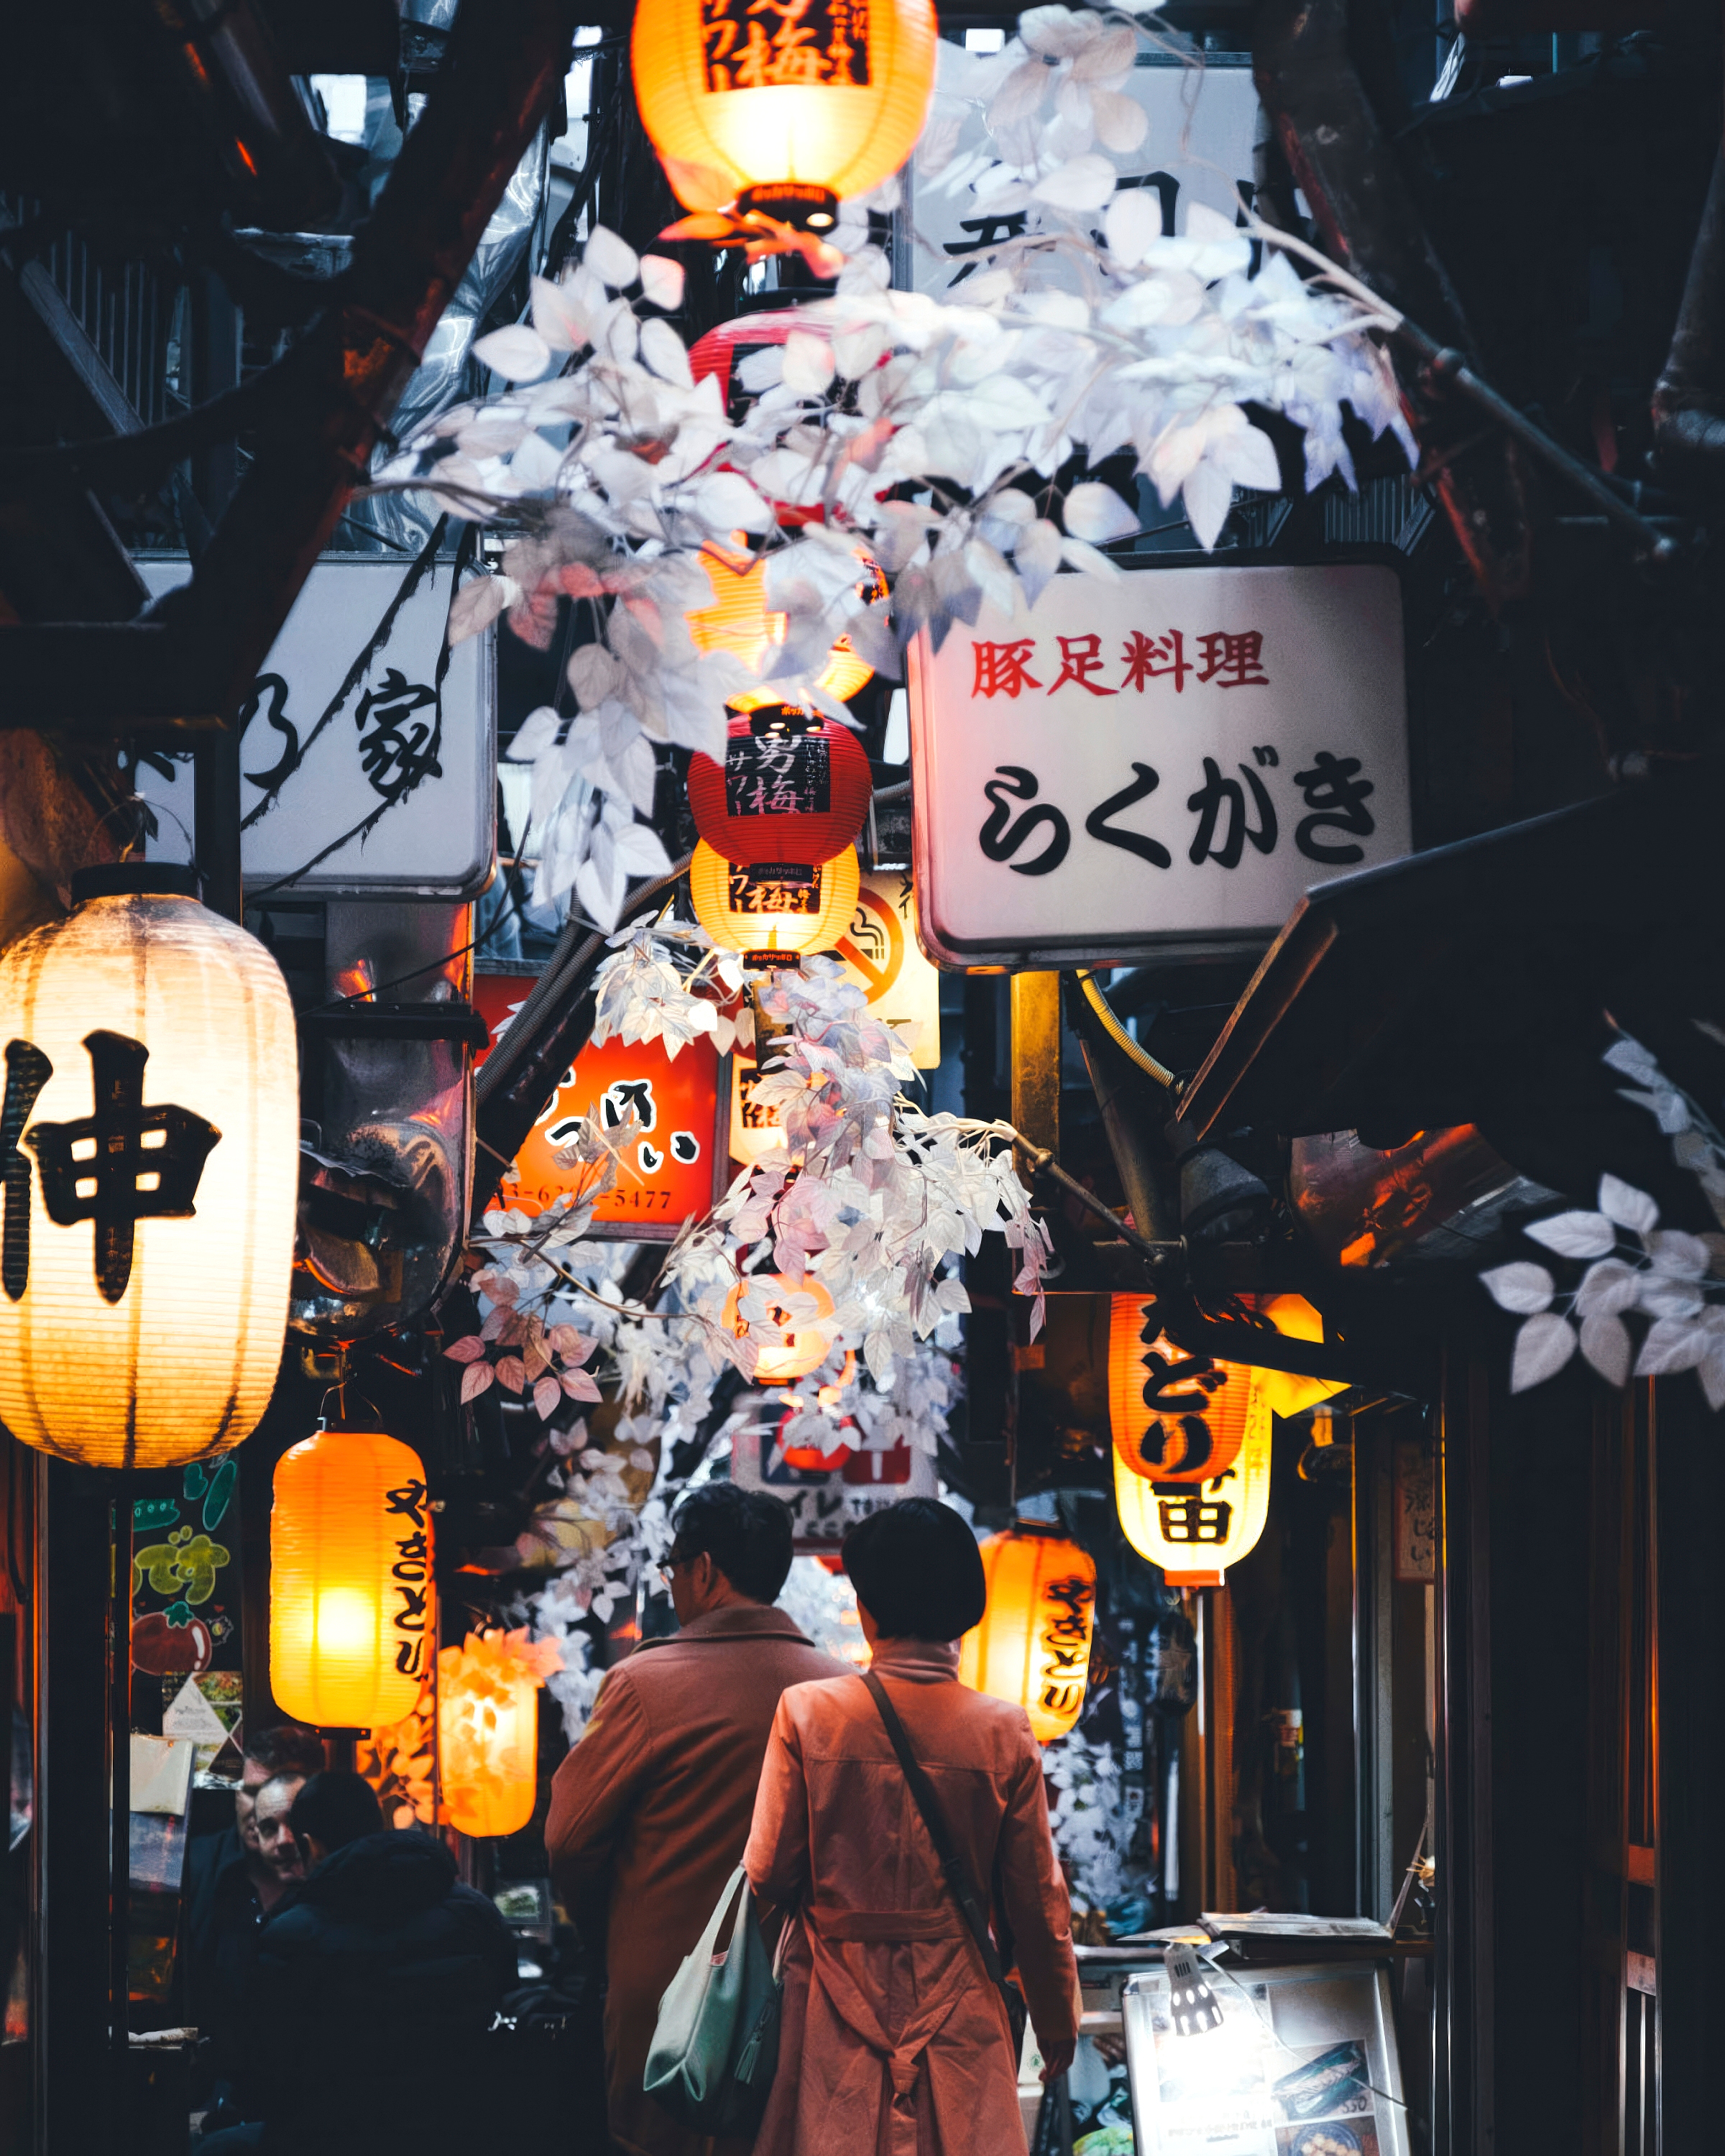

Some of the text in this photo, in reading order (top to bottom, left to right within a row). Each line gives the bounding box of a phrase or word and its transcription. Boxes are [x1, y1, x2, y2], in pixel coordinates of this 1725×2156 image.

[970, 629, 1271, 699] 豚足料理
[746, 734, 806, 815] 男梅
[979, 745, 1375, 877] らくがき
